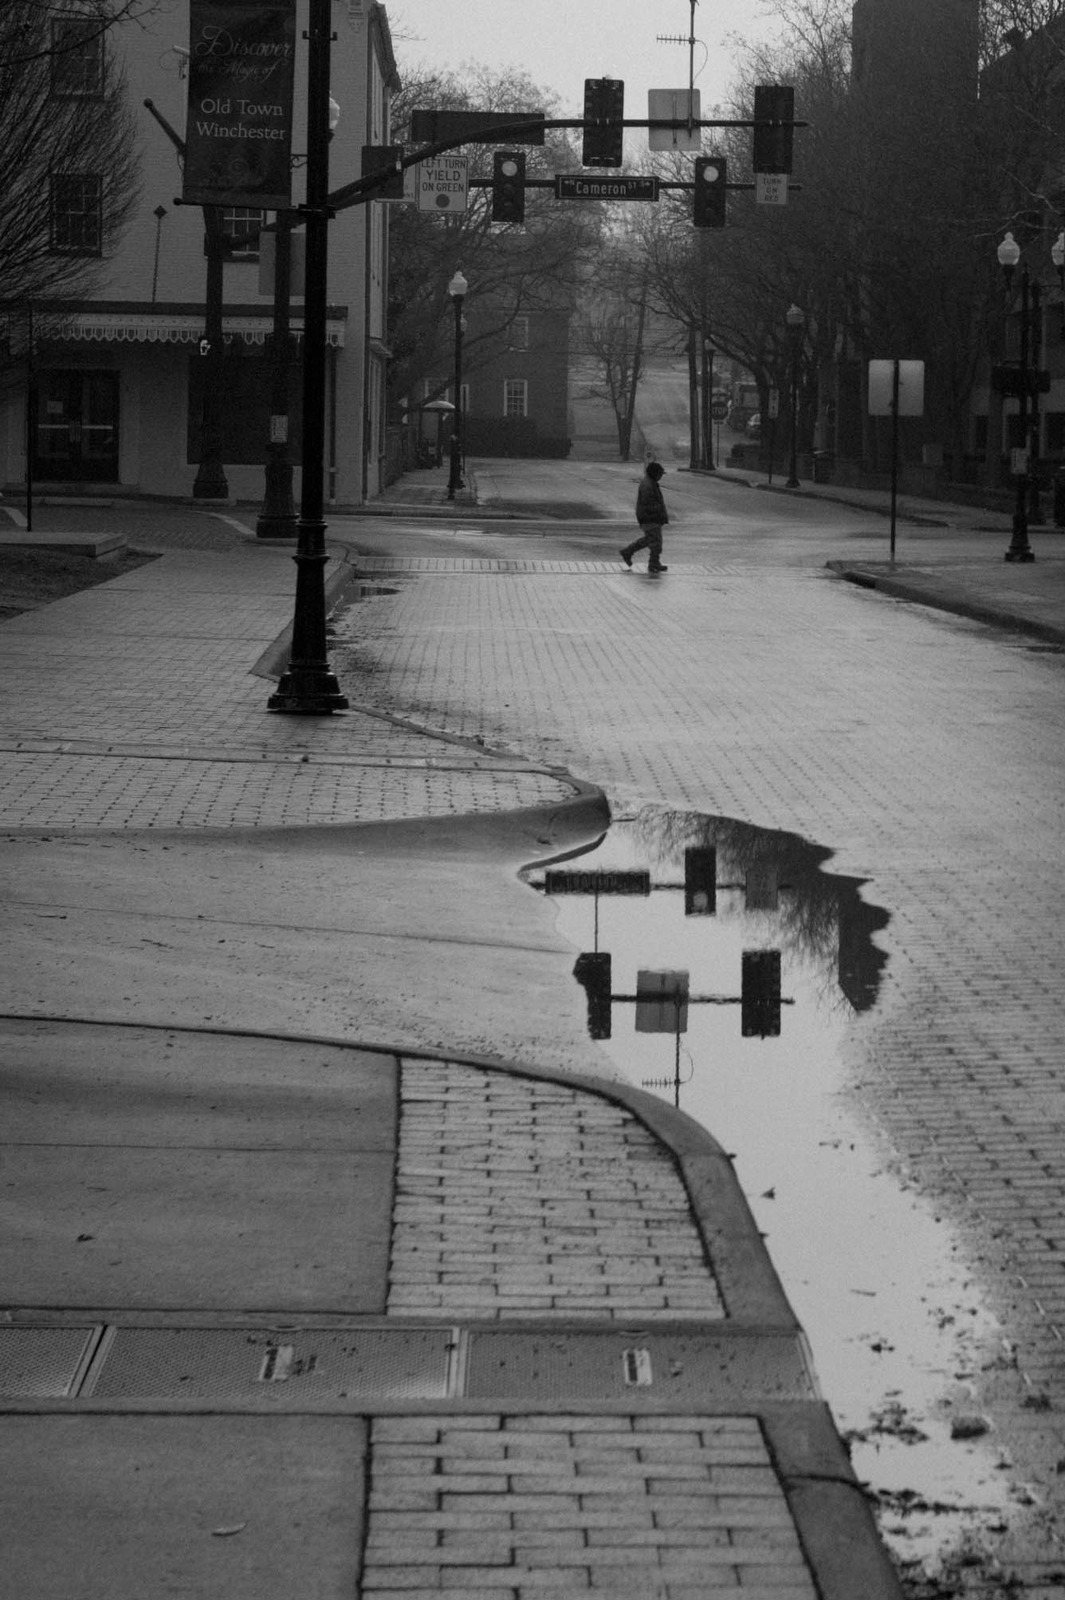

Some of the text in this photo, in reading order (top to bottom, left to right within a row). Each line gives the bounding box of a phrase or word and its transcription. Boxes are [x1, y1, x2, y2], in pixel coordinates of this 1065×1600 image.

[195, 25, 293, 57] Discover
[200, 98, 283, 116] Old Town
[195, 121, 286, 140] Winchester
[421, 158, 466, 169] LEFT TURN
[426, 169, 461, 181] YIELD
[422, 182, 464, 193] ON GREEN
[576, 181, 626, 195] Cameron
